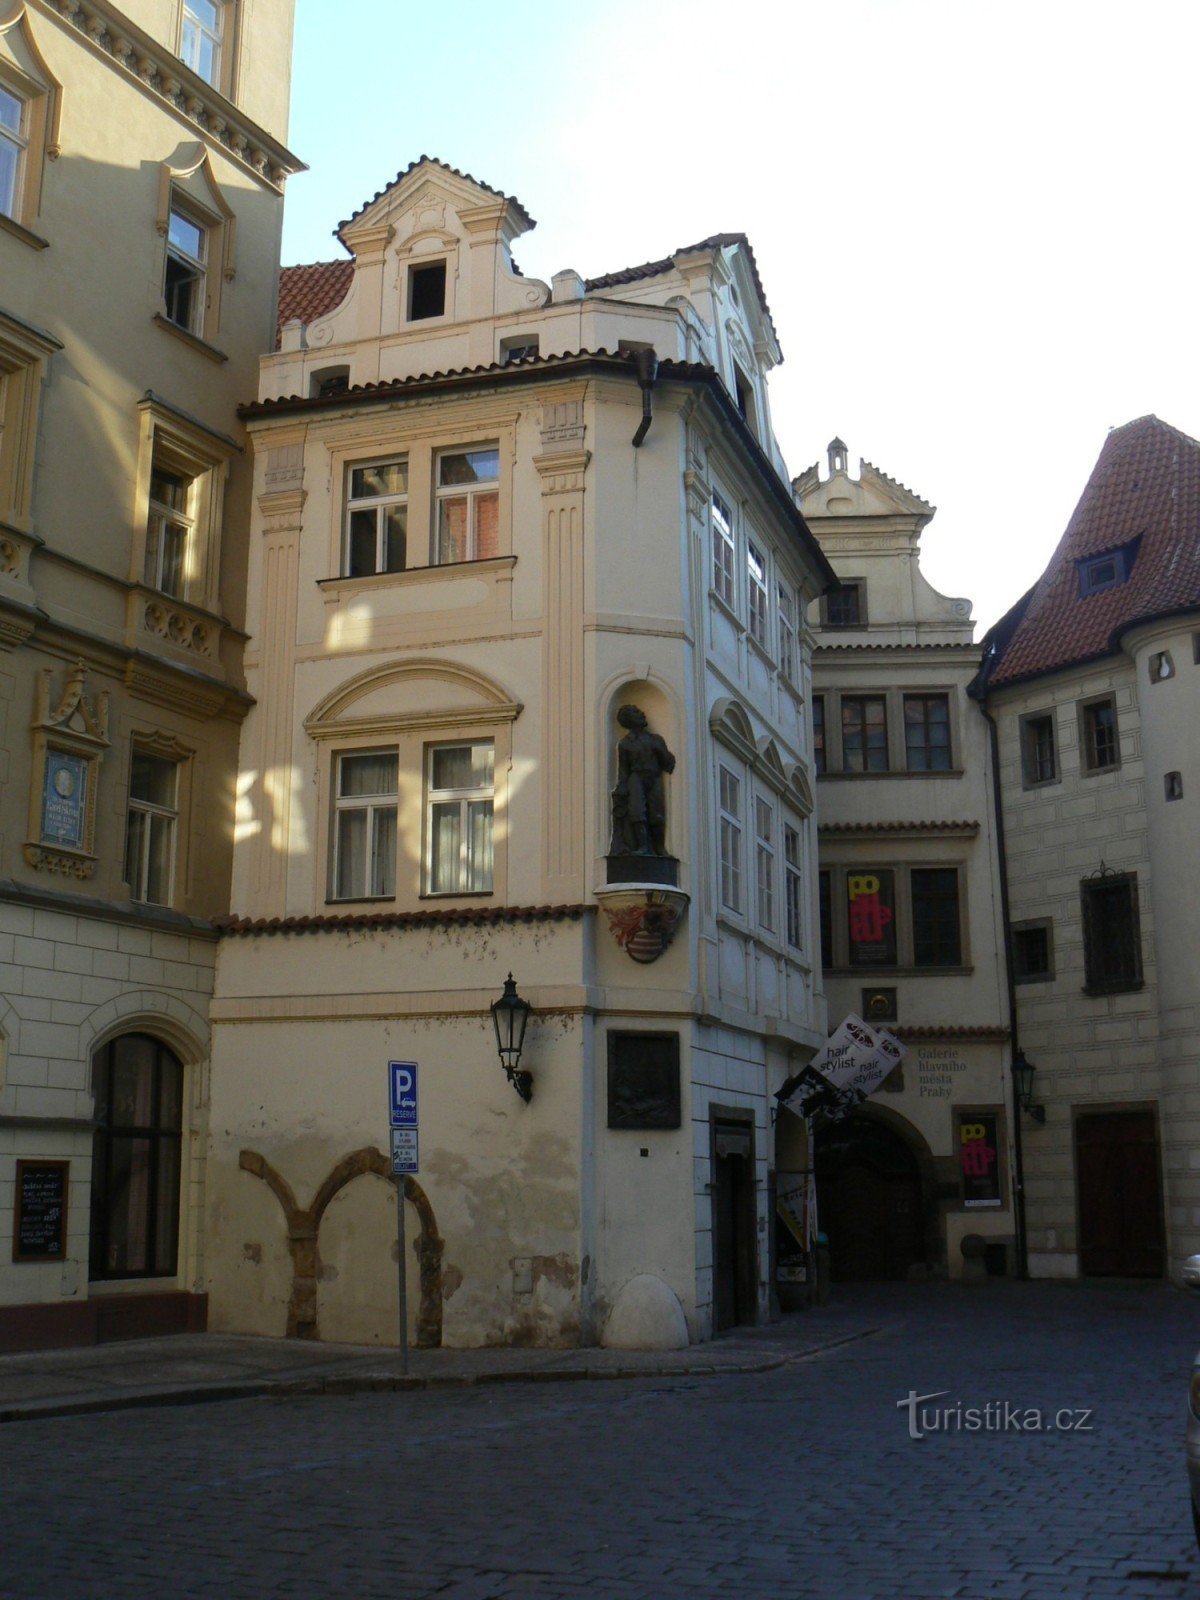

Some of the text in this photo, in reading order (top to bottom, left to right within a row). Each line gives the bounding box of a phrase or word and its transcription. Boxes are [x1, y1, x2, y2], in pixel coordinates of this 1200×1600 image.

[827, 1045, 850, 1058] hair
[918, 1047, 958, 1059] Galerie
[820, 1057, 856, 1072] stylist
[853, 1070, 883, 1084] stylist
[396, 1069, 412, 1105] P
[919, 1085, 952, 1099] Prahy
